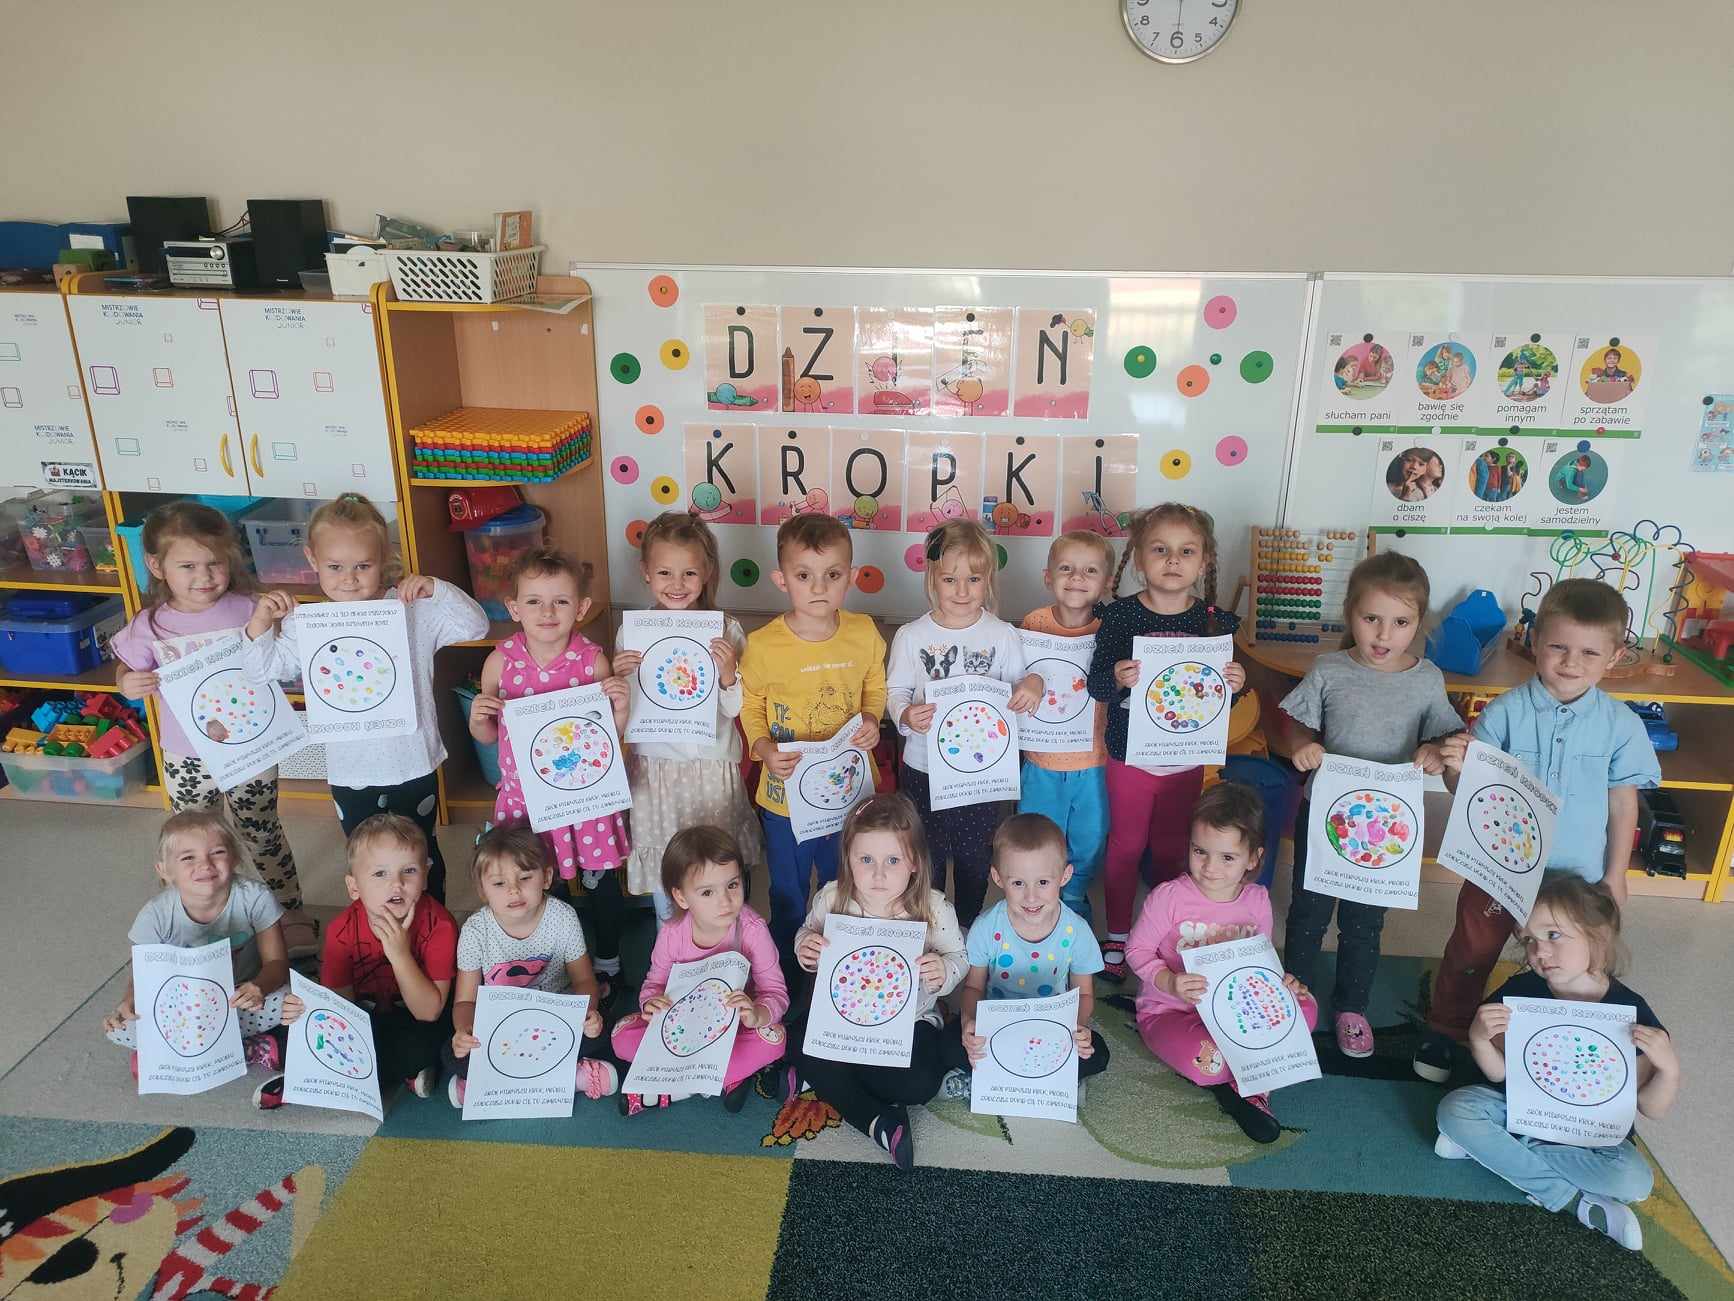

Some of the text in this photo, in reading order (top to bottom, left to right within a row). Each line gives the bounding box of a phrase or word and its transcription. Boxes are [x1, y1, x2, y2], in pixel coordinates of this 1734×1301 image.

[1140, 15, 1150, 26] 8
[1209, 16, 1219, 27] 4
[1152, 31, 1160, 42] 7
[1170, 31, 1184, 49] 6
[1194, 32, 1203, 43] 5
[1497, 404, 1547, 415] pomagam
[1325, 410, 1391, 421] słucham pani
[1420, 412, 1459, 423] zgodnie
[1505, 414, 1536, 424] innym
[1573, 415, 1631, 425] po zabawie
[63, 468, 88, 478] KĄCIK
[1397, 503, 1425, 512] dbam
[1474, 504, 1512, 513] czekam
[1554, 506, 1589, 516] jestem
[1392, 514, 1399, 522] o
[1456, 514, 1469, 522] na
[1503, 512, 1527, 523] kolej
[1540, 515, 1601, 526] samodzielny
